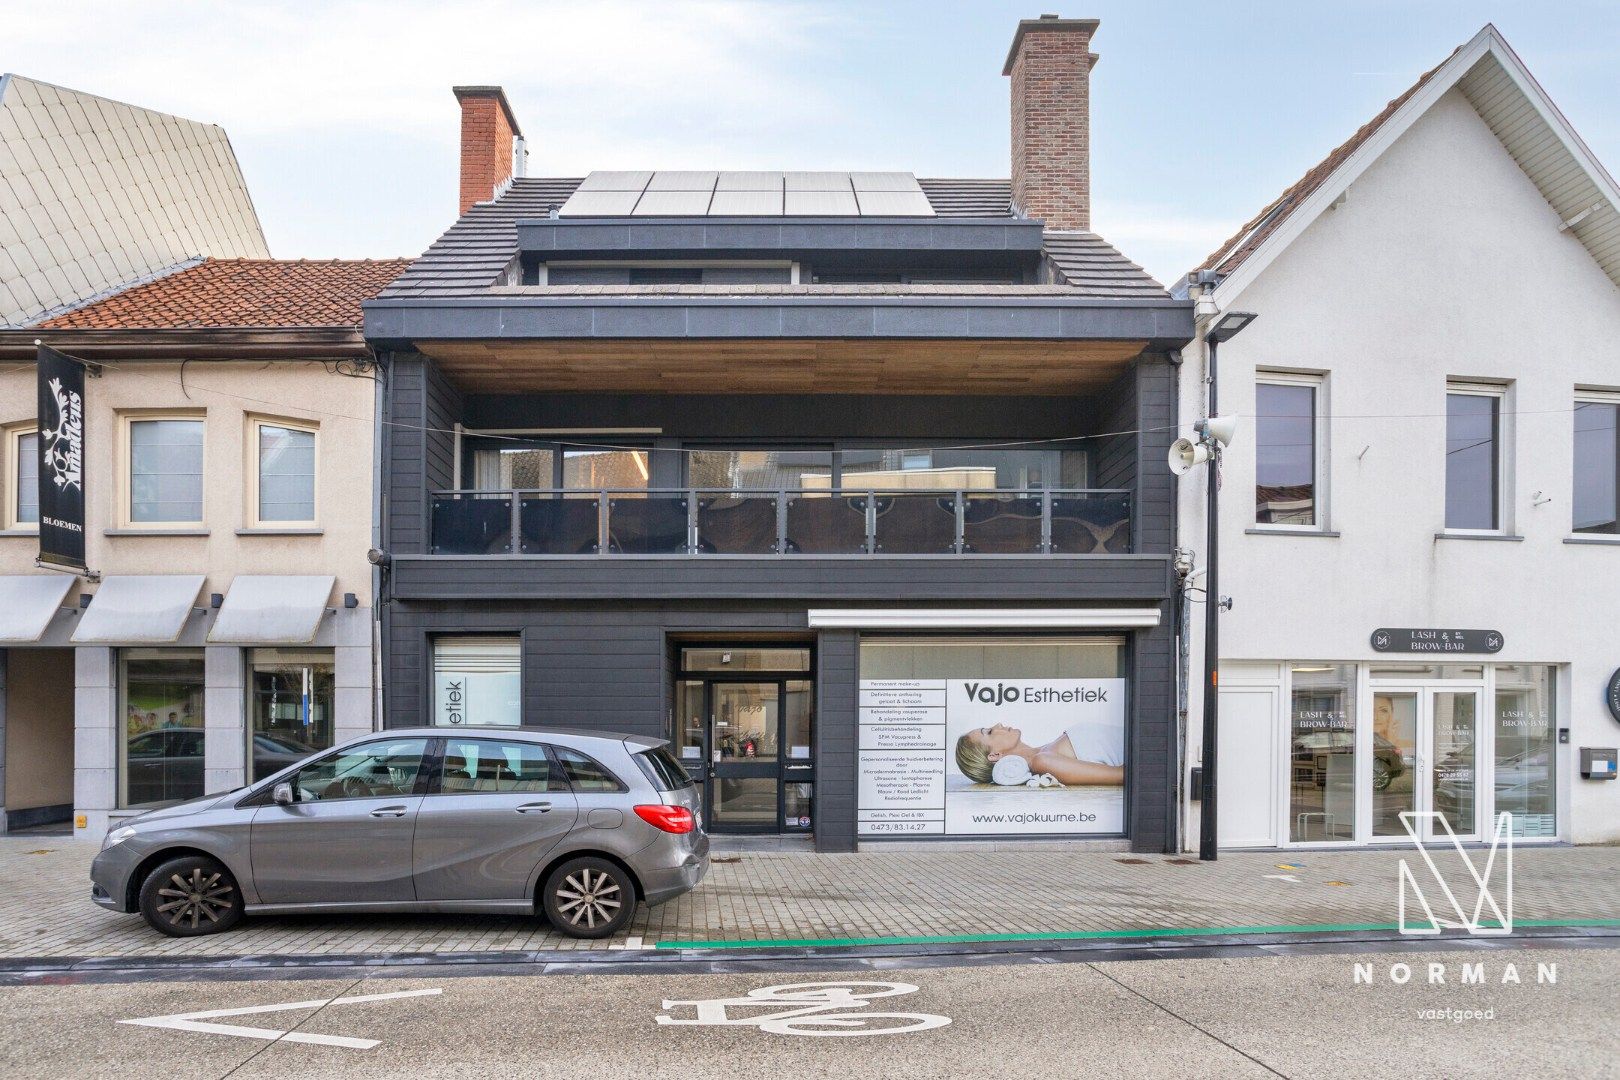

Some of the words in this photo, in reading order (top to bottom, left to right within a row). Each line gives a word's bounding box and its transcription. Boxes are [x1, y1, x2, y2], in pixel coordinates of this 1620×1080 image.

[66, 390, 82, 492] Amadeus
[43, 516, 82, 532] BLOEMEN
[1411, 631, 1436, 639] LASH
[1441, 632, 1449, 642] &
[1411, 642, 1465, 650] BROW-BAR
[964, 683, 1020, 706] Vajo
[1024, 687, 1108, 703] Esthetiek
[446, 681, 462, 724] etiek
[972, 812, 1096, 824] www.vajokuurne.be
[870, 824, 926, 832] 0473/83.14.27
